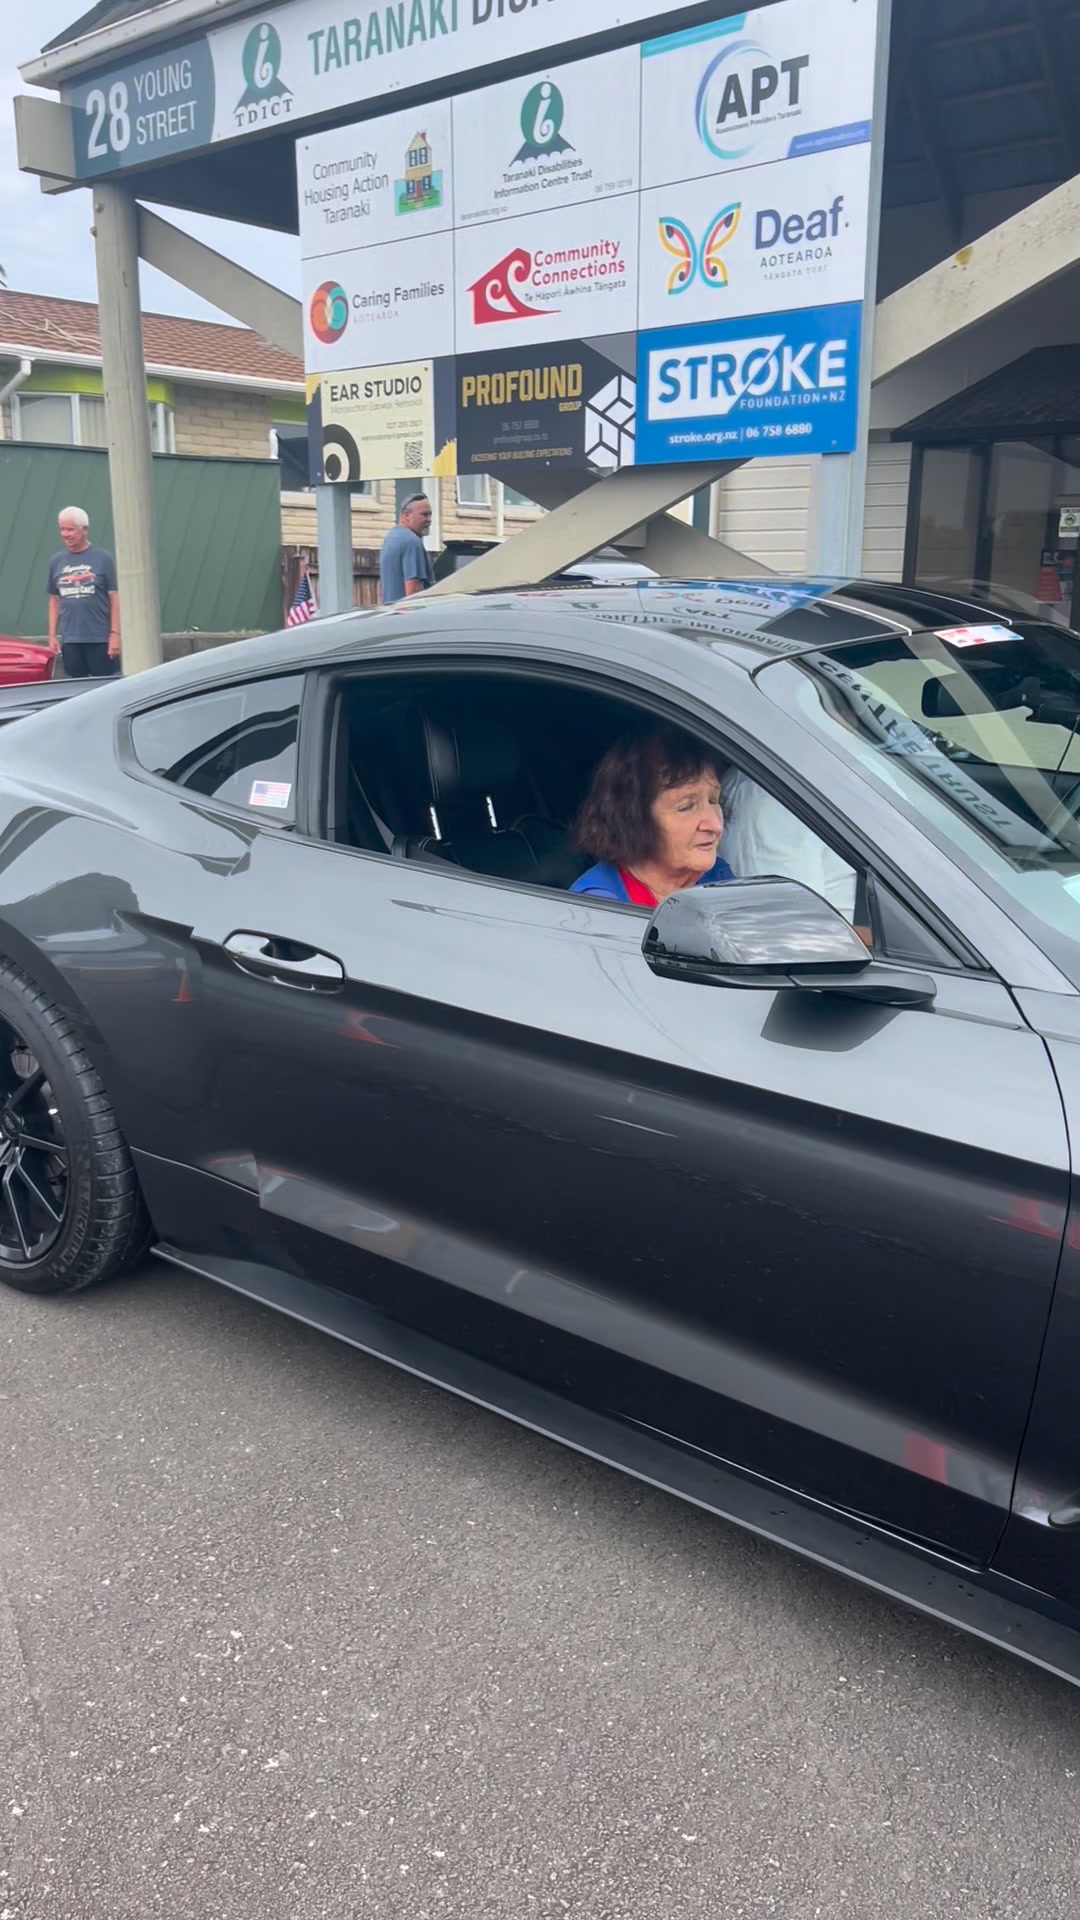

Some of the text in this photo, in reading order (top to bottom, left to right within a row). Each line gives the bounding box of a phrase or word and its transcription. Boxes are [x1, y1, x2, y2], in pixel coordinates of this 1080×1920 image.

[307, 0, 458, 75] TARANAKI
[133, 60, 192, 103] YOUNG
[716, 54, 810, 124] APT
[86, 82, 131, 159] 28
[136, 101, 198, 144] STREET
[235, 99, 294, 127] TDICT
[313, 152, 377, 181] Community
[502, 158, 583, 183] Taranaki Disabilities
[304, 174, 389, 206] Housing Action
[494, 169, 593, 199] Information Centre Trust
[323, 200, 370, 224] Taranaki
[534, 239, 621, 267] Community
[760, 246, 833, 268] AOTEAROA
[531, 260, 625, 287] Connections
[352, 281, 445, 309] Caring Families
[462, 363, 582, 408] PROFOUND
[658, 339, 847, 404] STROKE
[330, 376, 422, 402] EAR STUDIO
[669, 422, 812, 445] stroke.org.nz 06 758 6880
